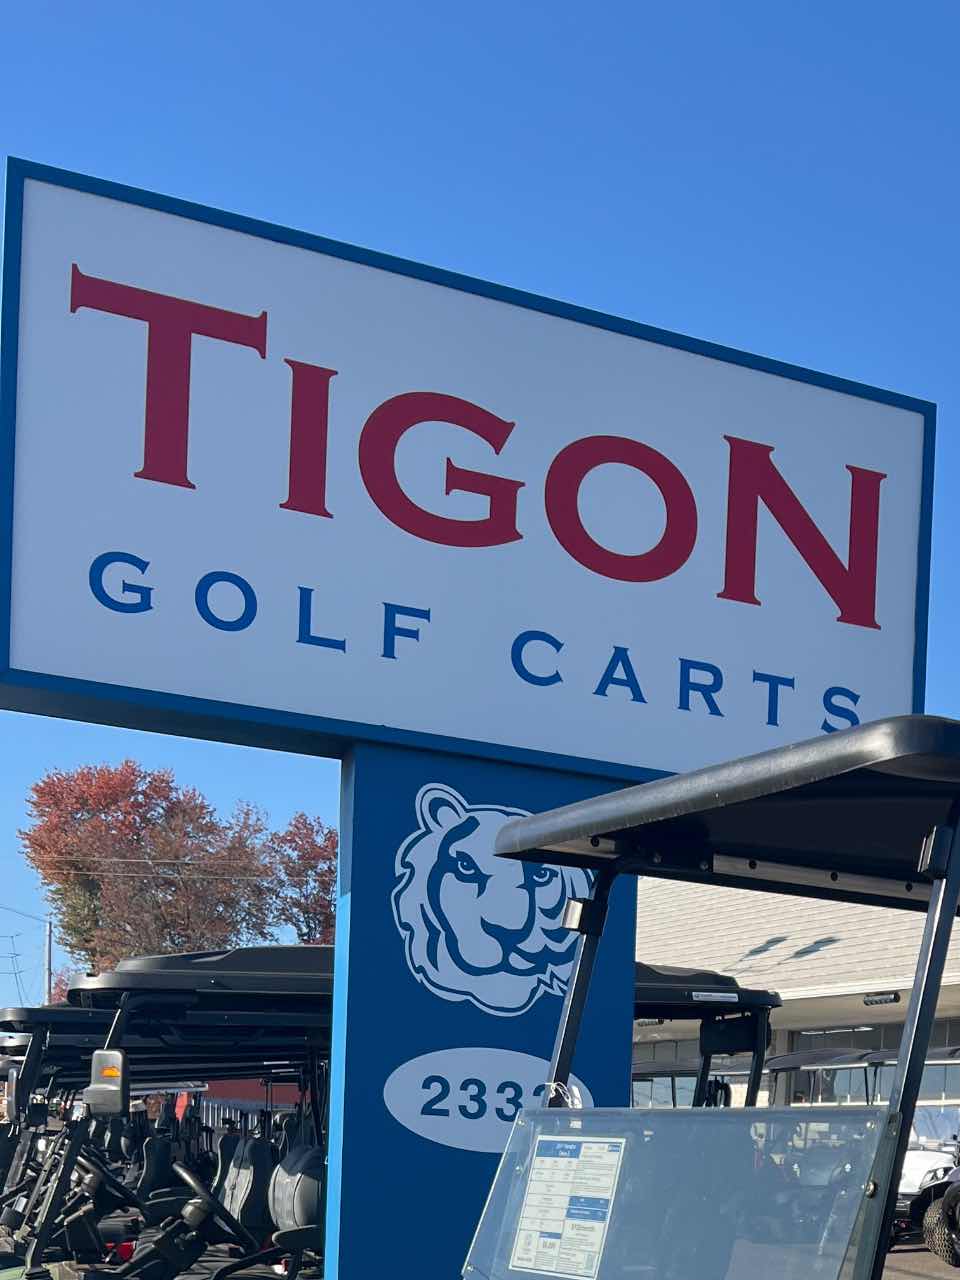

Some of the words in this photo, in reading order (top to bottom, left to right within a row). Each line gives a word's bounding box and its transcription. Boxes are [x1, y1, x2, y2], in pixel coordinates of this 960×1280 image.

[70, 263, 887, 630] TIGON
[89, 550, 432, 660] GOLF
[511, 629, 862, 733] CARTS
